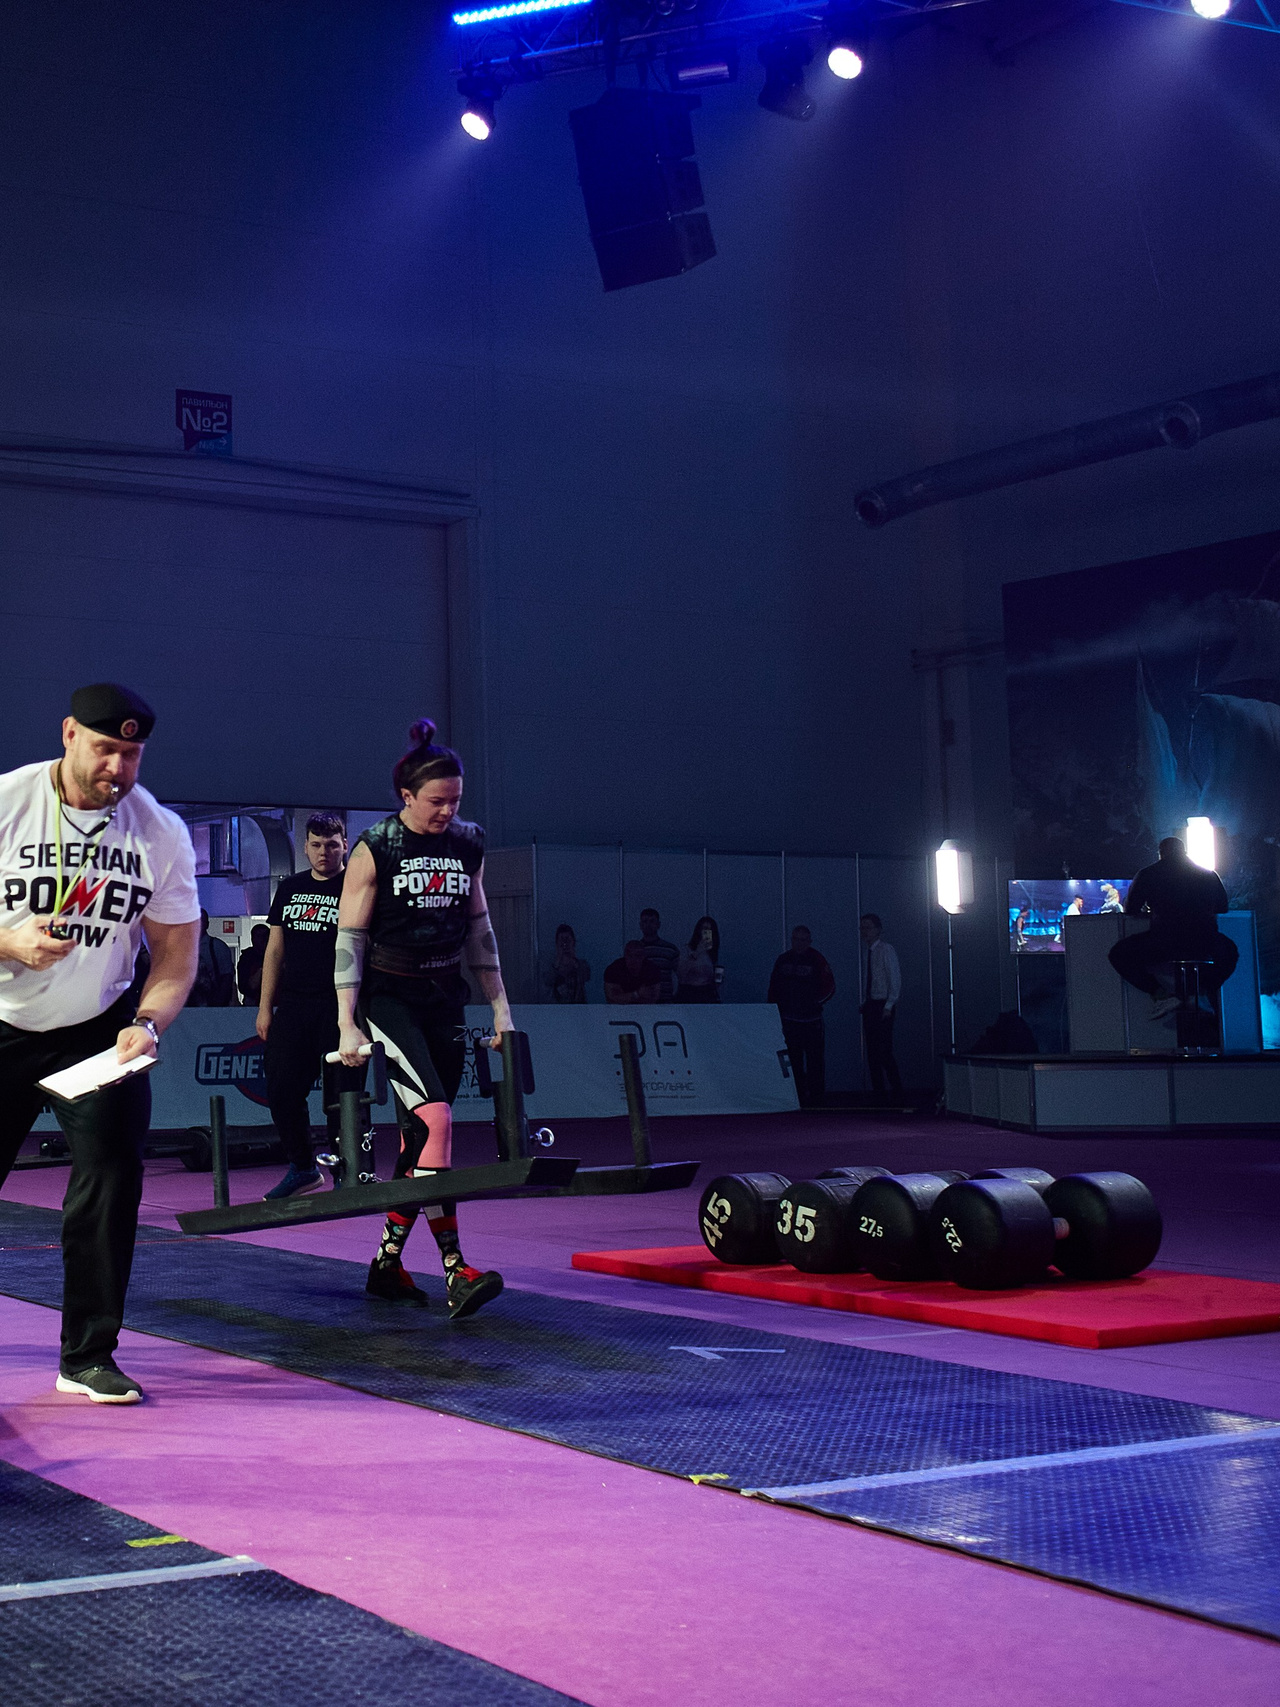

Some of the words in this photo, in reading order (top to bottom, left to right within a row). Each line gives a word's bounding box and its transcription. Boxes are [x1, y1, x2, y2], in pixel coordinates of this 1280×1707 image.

[182, 397, 228, 409] ПАВИЛЬОН
[182, 407, 228, 434] №2
[19, 842, 141, 879] SIBERIAN
[400, 856, 464, 873] SIBERIAN
[392, 872, 470, 897] POWER
[4, 875, 153, 924] POWER
[290, 893, 338, 907] SIBERIAN
[416, 896, 452, 908] SHOW
[282, 904, 339, 925] POWER
[293, 920, 322, 932] SHOW
[703, 1191, 732, 1248] 45
[776, 1199, 817, 1243] 35
[858, 1215, 884, 1238] 27,5
